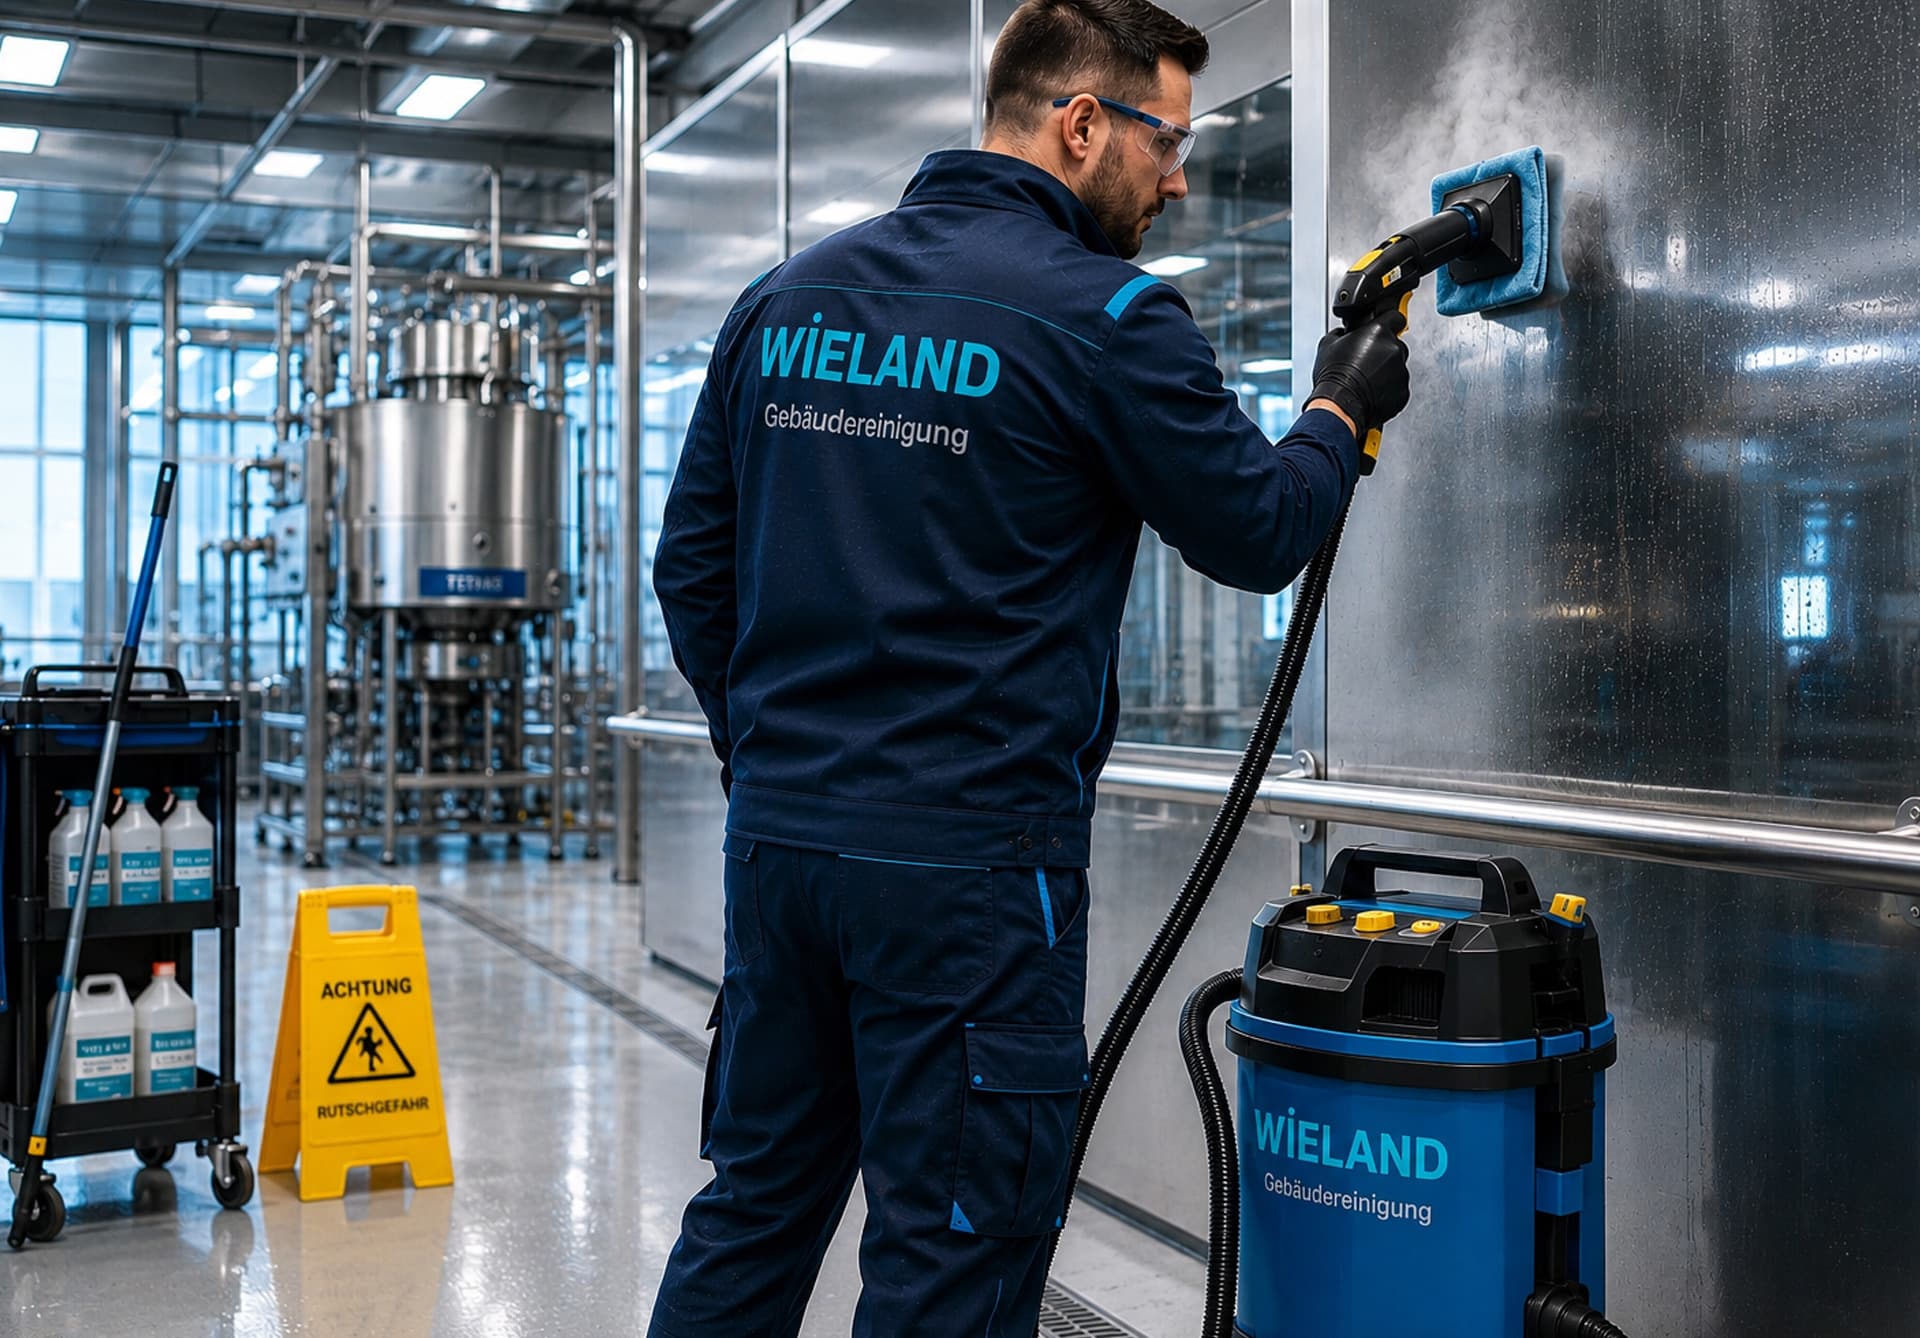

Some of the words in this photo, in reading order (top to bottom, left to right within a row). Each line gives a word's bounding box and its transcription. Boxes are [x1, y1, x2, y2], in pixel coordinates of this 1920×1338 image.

[764, 403, 969, 455] Gebäudereinigung
[321, 977, 412, 999] ACHTUNG
[317, 1096, 430, 1119] RUTSCHGEFAHR
[1264, 1172, 1432, 1226] Gebäudereinigung
